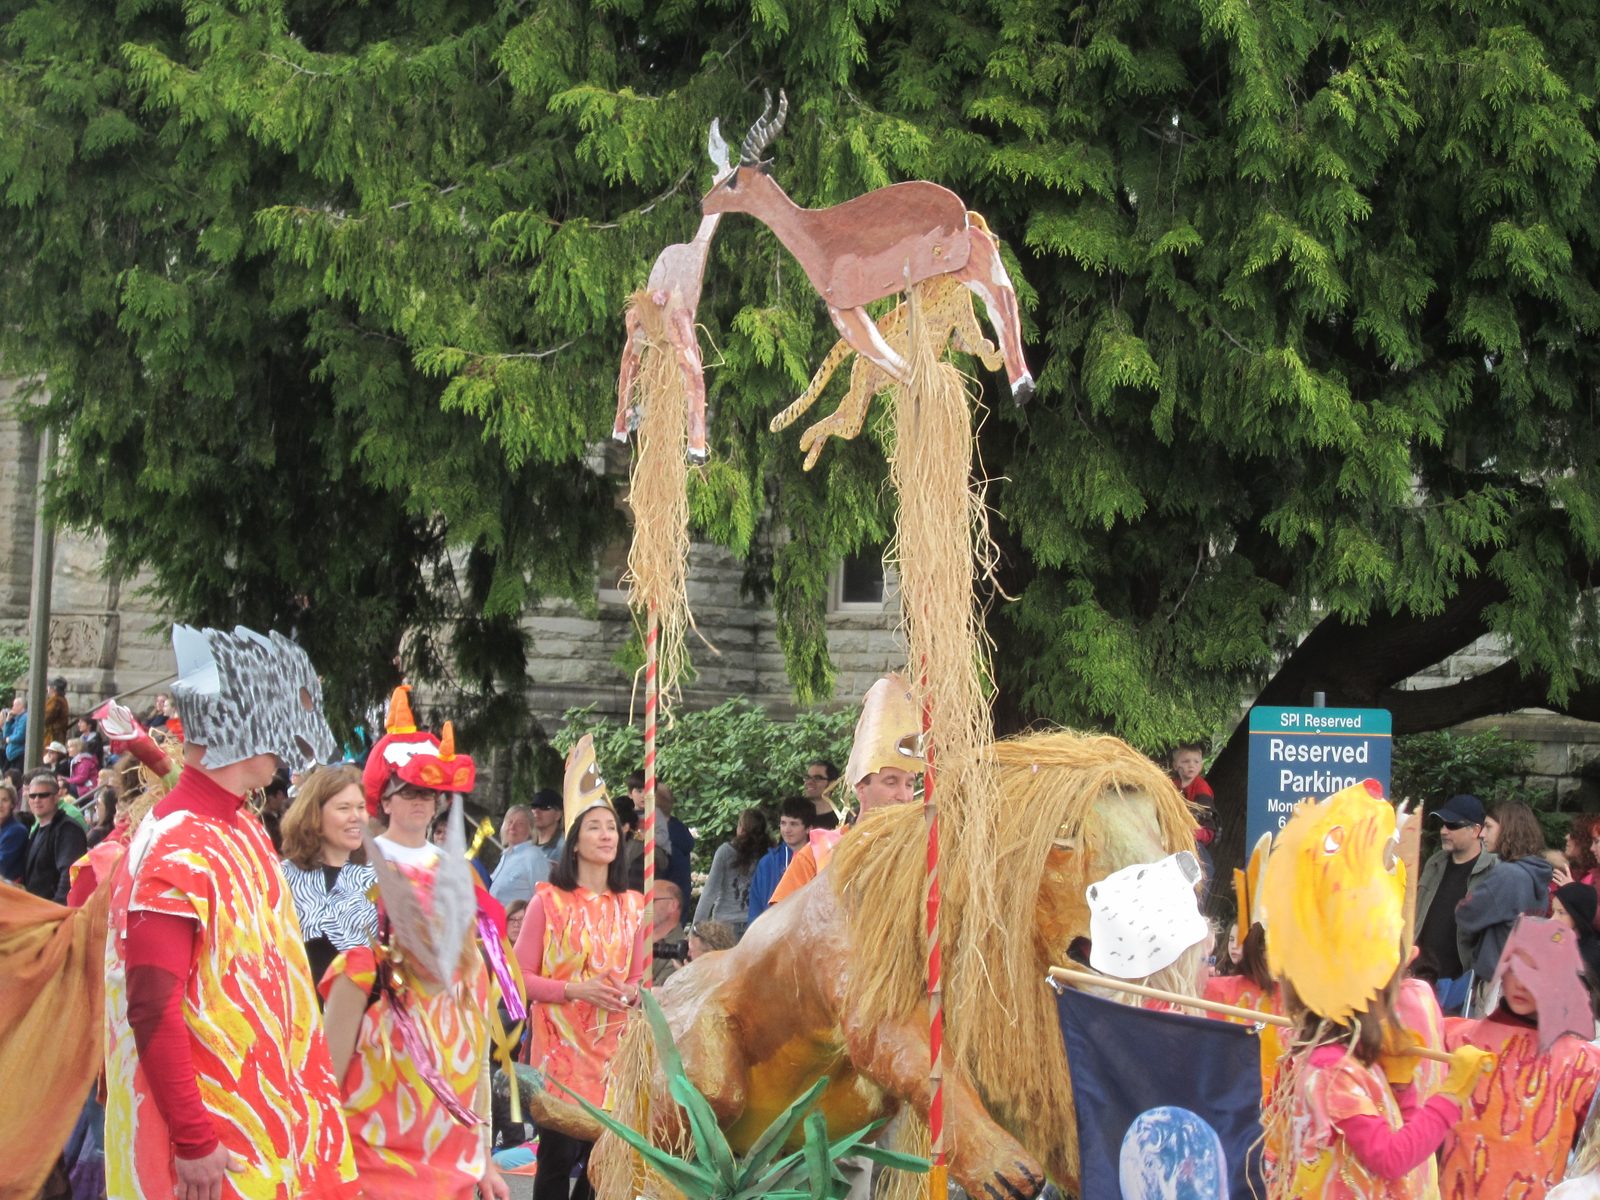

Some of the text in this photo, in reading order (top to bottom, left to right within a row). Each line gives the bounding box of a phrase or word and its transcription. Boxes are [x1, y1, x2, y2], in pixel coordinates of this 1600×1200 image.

[1280, 713, 1362, 728] SPI Reserved
[1269, 739, 1369, 764] Reserved
[1267, 799, 1300, 812] Mon
